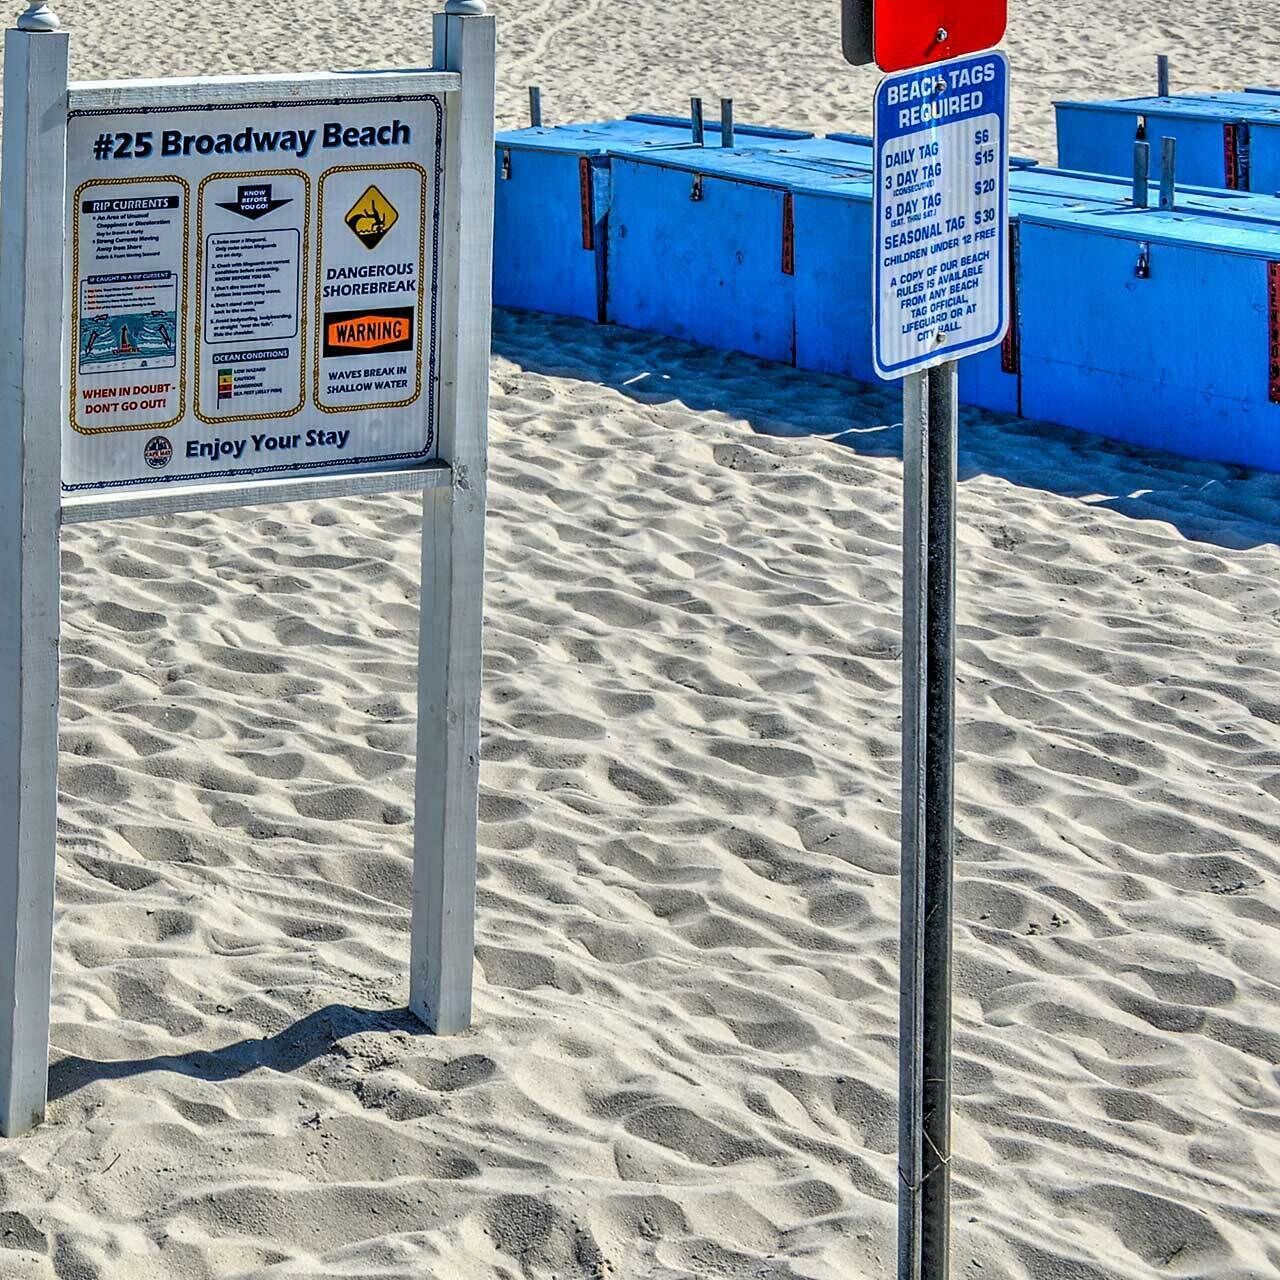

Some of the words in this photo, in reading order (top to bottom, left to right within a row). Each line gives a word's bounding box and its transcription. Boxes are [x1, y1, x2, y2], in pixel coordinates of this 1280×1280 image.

[887, 75, 943, 106] BEACH
[949, 63, 995, 89] TAGS
[899, 91, 983, 128] REQUIRED
[93, 132, 153, 161] #25
[160, 127, 317, 158] Broadway
[321, 120, 412, 148] Beach
[885, 148, 915, 168] DAILY
[919, 142, 939, 159] TAG
[974, 149, 994, 166] $15
[885, 175, 892, 190] 3
[896, 169, 918, 187] DAY
[922, 163, 942, 180] TAG
[974, 178, 995, 195] $20
[92, 201, 111, 212] RIP
[112, 198, 169, 210] CURRENTS
[885, 206, 892, 220] 8
[896, 199, 918, 217] DAY
[922, 193, 942, 210] TAG
[884, 222, 942, 250] SEASONAL
[945, 216, 965, 233] TAG
[974, 208, 995, 225] $30
[883, 247, 928, 267] CHILDREN
[930, 238, 959, 254] UNDER
[962, 234, 971, 245] 12
[974, 228, 996, 241] FREE
[326, 262, 414, 280] DANGEROUS
[890, 277, 897, 287] A
[900, 269, 924, 284] COPY
[926, 265, 937, 276] OF
[940, 259, 958, 272] OUR
[960, 250, 990, 267] BEACH
[896, 282, 924, 298] RULES
[926, 279, 934, 289] IS
[938, 265, 983, 286] AVAILABLE
[322, 279, 417, 298] SHOREBREAK
[900, 294, 926, 309] FROM
[929, 288, 947, 301] ANY
[949, 278, 979, 294] BEACH
[902, 312, 947, 334] LIFEGUARD
[950, 308, 963, 319] OR
[966, 303, 977, 314] AT
[911, 306, 927, 318] TAG
[336, 320, 402, 343] WARNING
[917, 328, 935, 342] CITY
[213, 354, 241, 362] OCEAN
[241, 350, 288, 360] CONDITIONS
[328, 369, 362, 380] WAVES
[363, 367, 395, 378] BREAK
[396, 366, 407, 375] IN
[82, 388, 117, 399] WHEN
[119, 387, 131, 396] IN
[133, 384, 171, 395] DOUBT
[326, 382, 373, 394] SHALLOW
[374, 379, 408, 390] WATER
[85, 403, 120, 414] DON'T
[121, 401, 138, 411] GO
[140, 399, 167, 409] OUT!
[186, 438, 247, 461] Enjoy
[250, 432, 301, 452] Your
[305, 429, 350, 448] Stay
